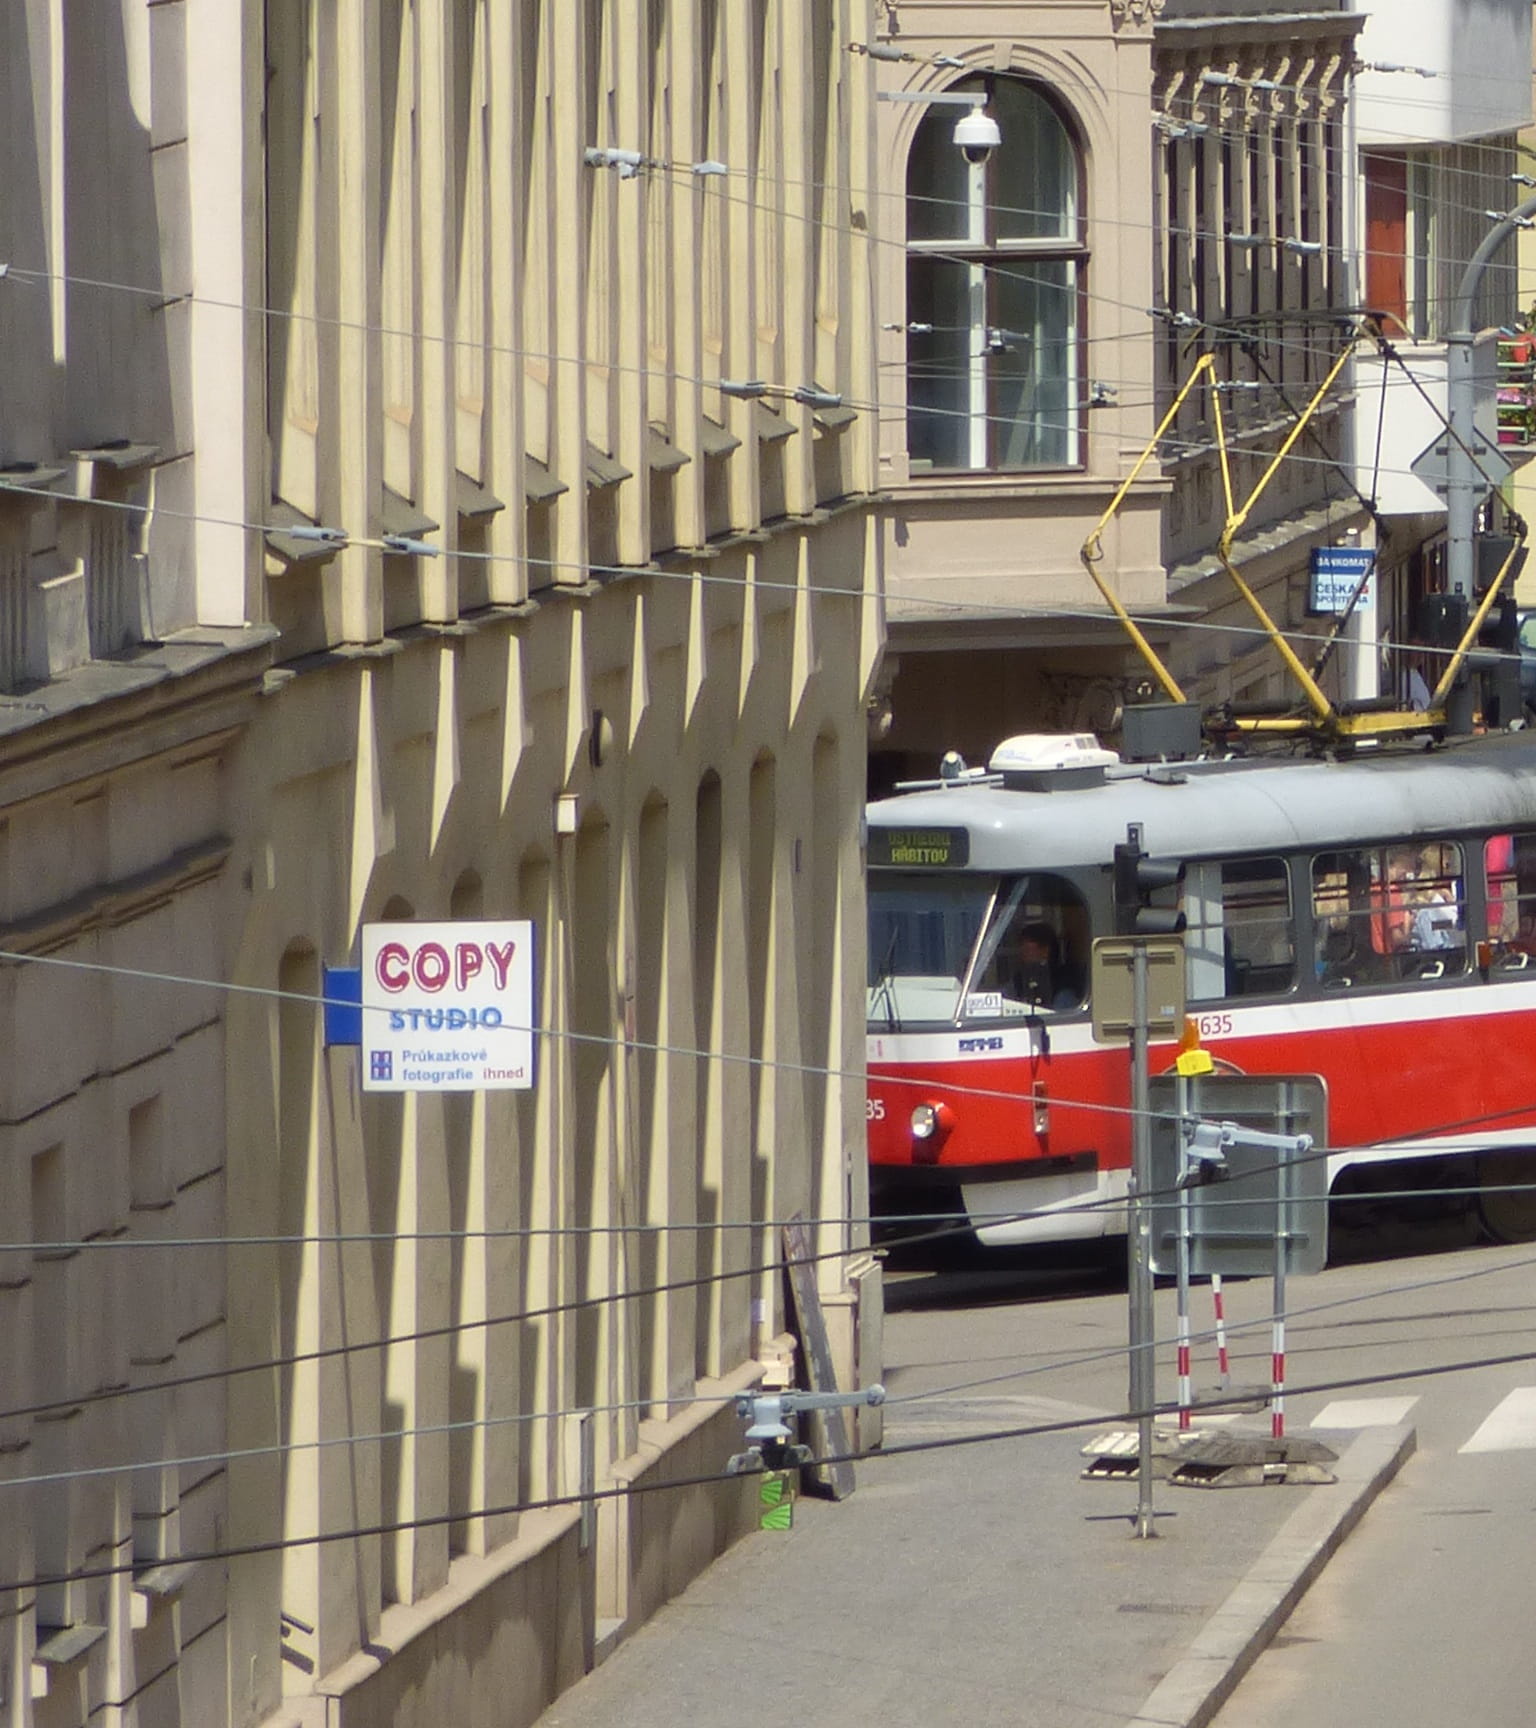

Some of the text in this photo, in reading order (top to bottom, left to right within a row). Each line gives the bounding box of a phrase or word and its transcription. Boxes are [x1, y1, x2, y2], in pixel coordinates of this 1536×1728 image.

[375, 940, 516, 994] COPY
[388, 1005, 503, 1033] STUDIO
[402, 1049, 488, 1063] Průkazkové
[402, 1066, 524, 1084] fotografie ihned
